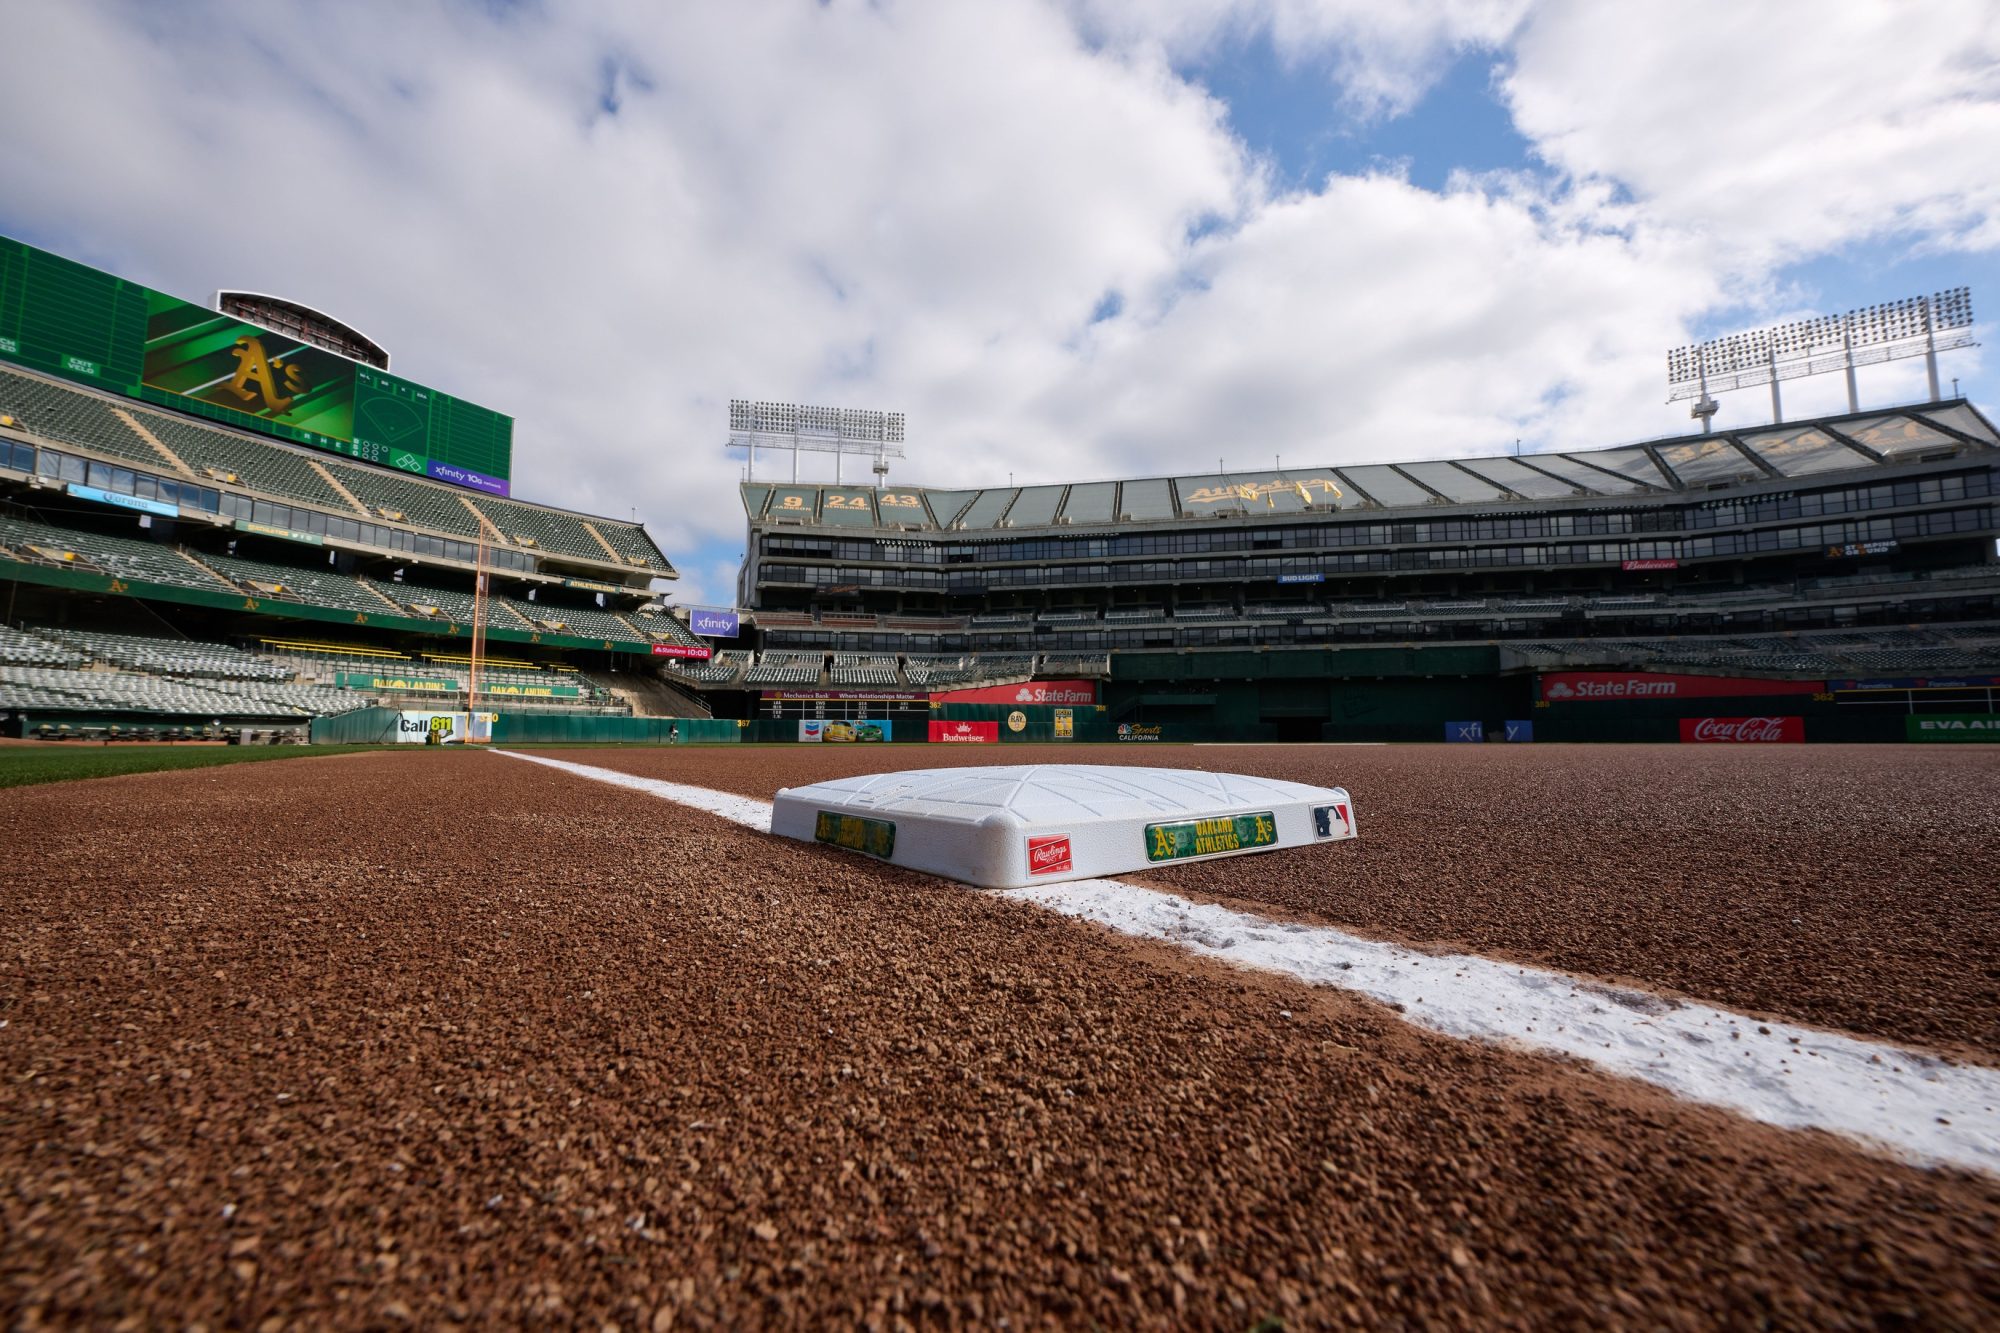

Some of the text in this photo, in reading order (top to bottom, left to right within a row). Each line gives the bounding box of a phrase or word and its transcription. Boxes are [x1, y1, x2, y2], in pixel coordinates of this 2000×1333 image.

[68, 362, 94, 374] VELO
[216, 335, 306, 416] A's
[435, 466, 466, 481] xfinity
[103, 492, 149, 509] Corona
[784, 496, 803, 507] 9
[828, 495, 868, 508] 24
[880, 494, 919, 505] 43
[1626, 560, 1676, 570] Budweiser
[697, 617, 733, 631] xfinity
[687, 649, 708, 657] 10:08
[1813, 693, 1835, 701] 362
[400, 716, 453, 732] Call 811
[1011, 714, 1023, 723] RAY
[1131, 723, 1162, 736] Sports
[1694, 717, 1786, 741] Coca-Cola
[1920, 721, 1967, 730] EVA
[1255, 815, 1274, 843] A's
[1153, 818, 1233, 857] A's OAKLAND
[1195, 834, 1240, 854] ATHLETICS
[1034, 845, 1067, 862] Rawlings
